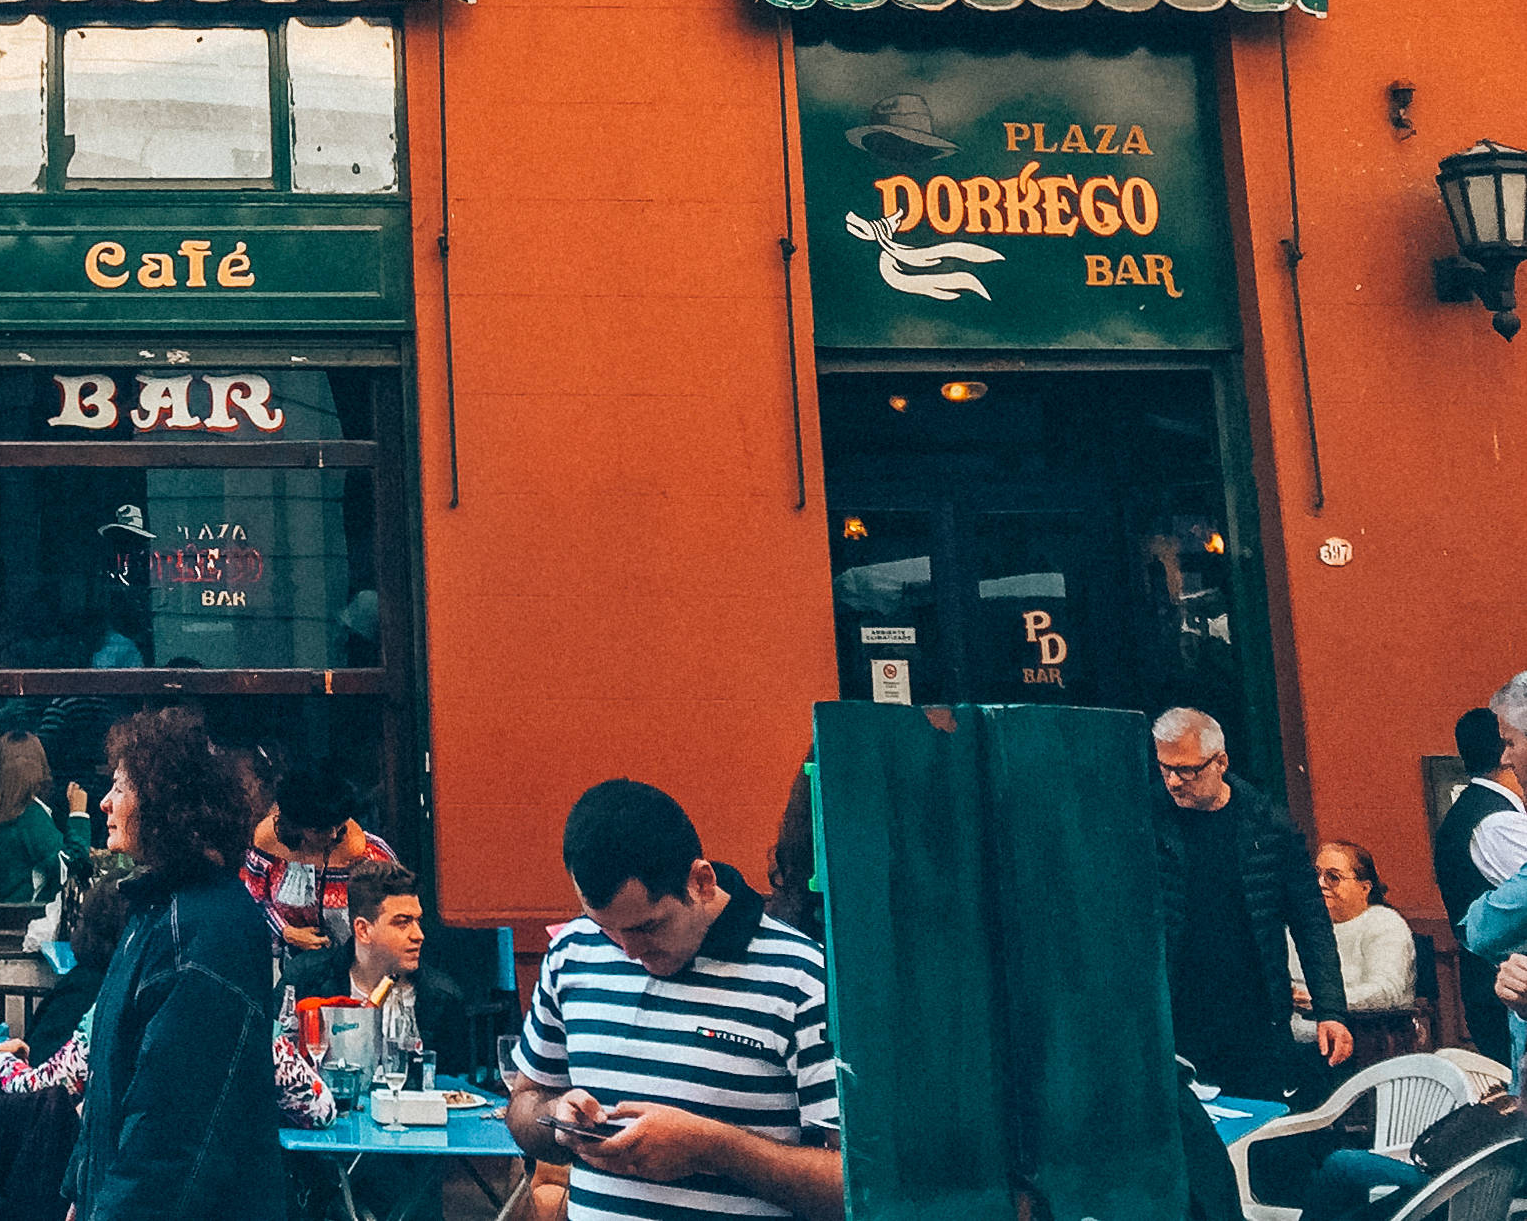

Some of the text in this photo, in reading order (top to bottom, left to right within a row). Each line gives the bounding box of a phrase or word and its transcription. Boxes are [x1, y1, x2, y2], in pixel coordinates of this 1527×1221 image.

[1003, 122, 1154, 156] PLAZA
[874, 161, 1160, 237] DORREGO
[84, 240, 256, 289] Café
[1084, 254, 1183, 299] BAR
[47, 373, 285, 433] BAR
[201, 590, 246, 608] BAR
[1022, 668, 1065, 689] BAR
